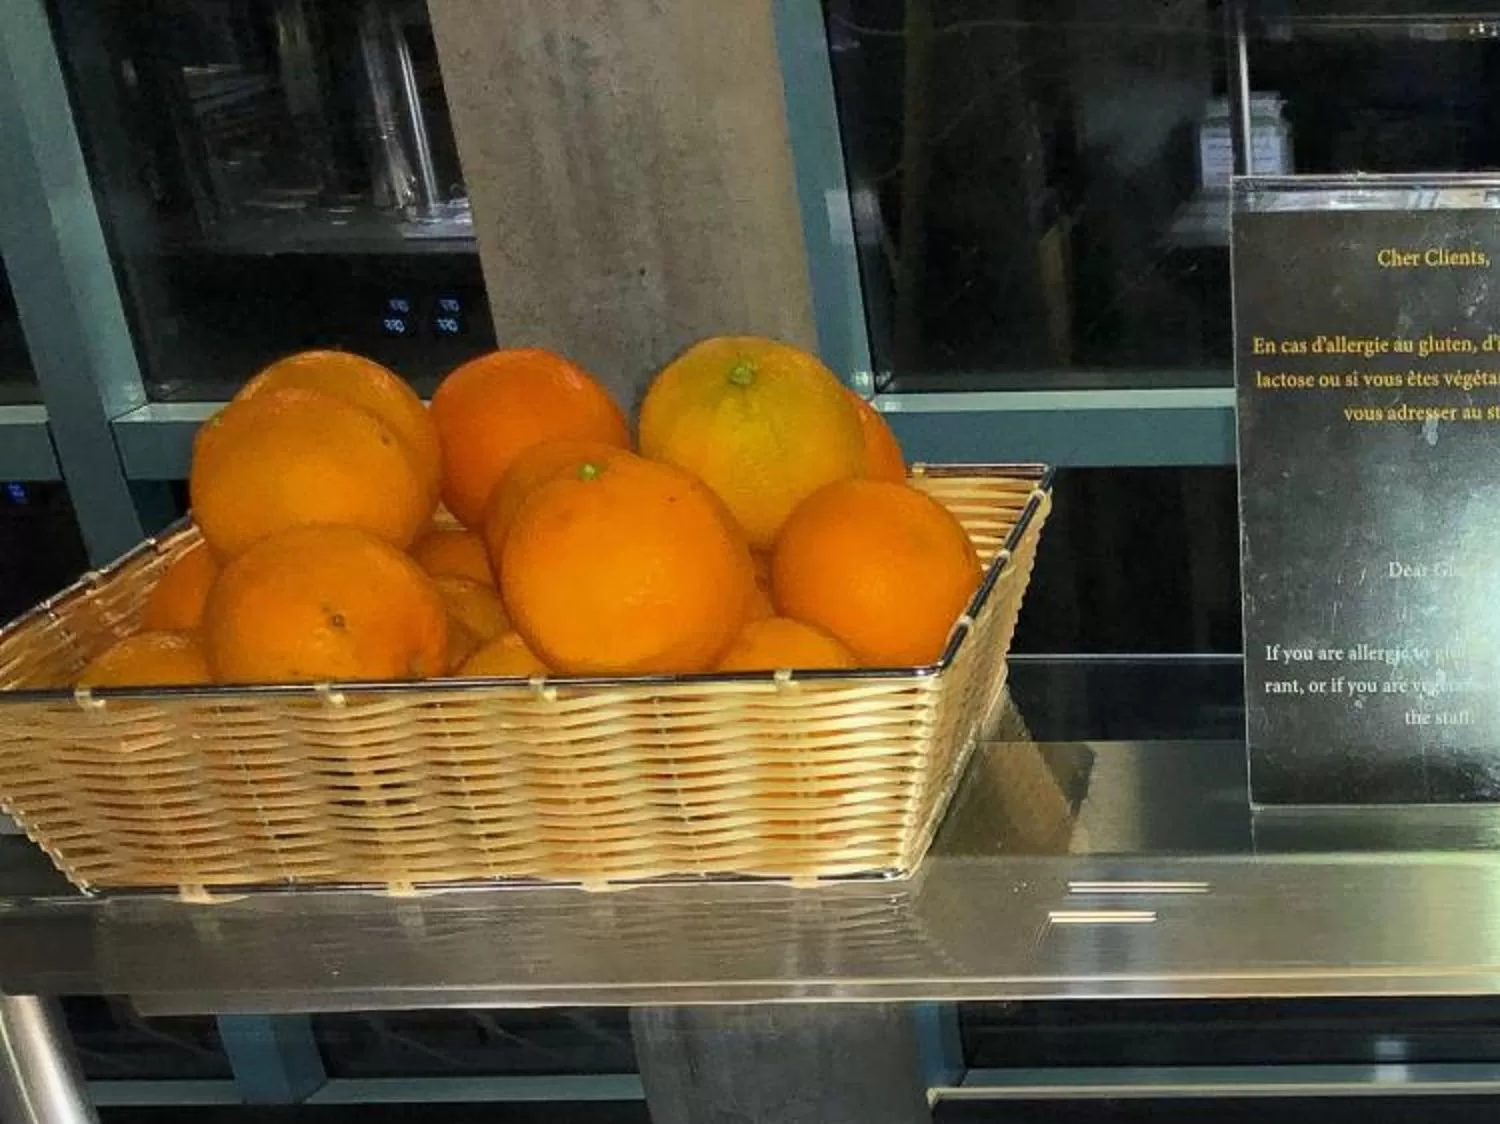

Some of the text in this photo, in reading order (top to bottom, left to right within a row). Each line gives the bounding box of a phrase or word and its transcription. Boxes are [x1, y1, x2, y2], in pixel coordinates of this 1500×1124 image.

[1377, 247, 1491, 269] Cher Clients,
[1253, 336, 1276, 354] En
[1281, 341, 1307, 354] cas
[1312, 335, 1389, 358] d'allergie
[1393, 339, 1413, 353] au
[1419, 335, 1477, 357] gluten,
[1256, 370, 1315, 388] lactose
[1319, 374, 1341, 388] ou
[1345, 370, 1359, 387] si
[1363, 373, 1403, 388] vous
[1407, 369, 1440, 388] êtes
[1344, 407, 1383, 421] vous
[1387, 403, 1457, 422] adresser
[1462, 405, 1481, 420] au
[1389, 561, 1427, 577] Dear
[1266, 644, 1281, 661] If
[1282, 648, 1314, 665] you
[1318, 648, 1345, 661] are
[1265, 679, 1305, 695] rant,
[1308, 680, 1327, 693] or
[1331, 676, 1346, 692] if
[1348, 680, 1377, 697] you
[1382, 679, 1409, 693] are
[1405, 708, 1431, 725] the
